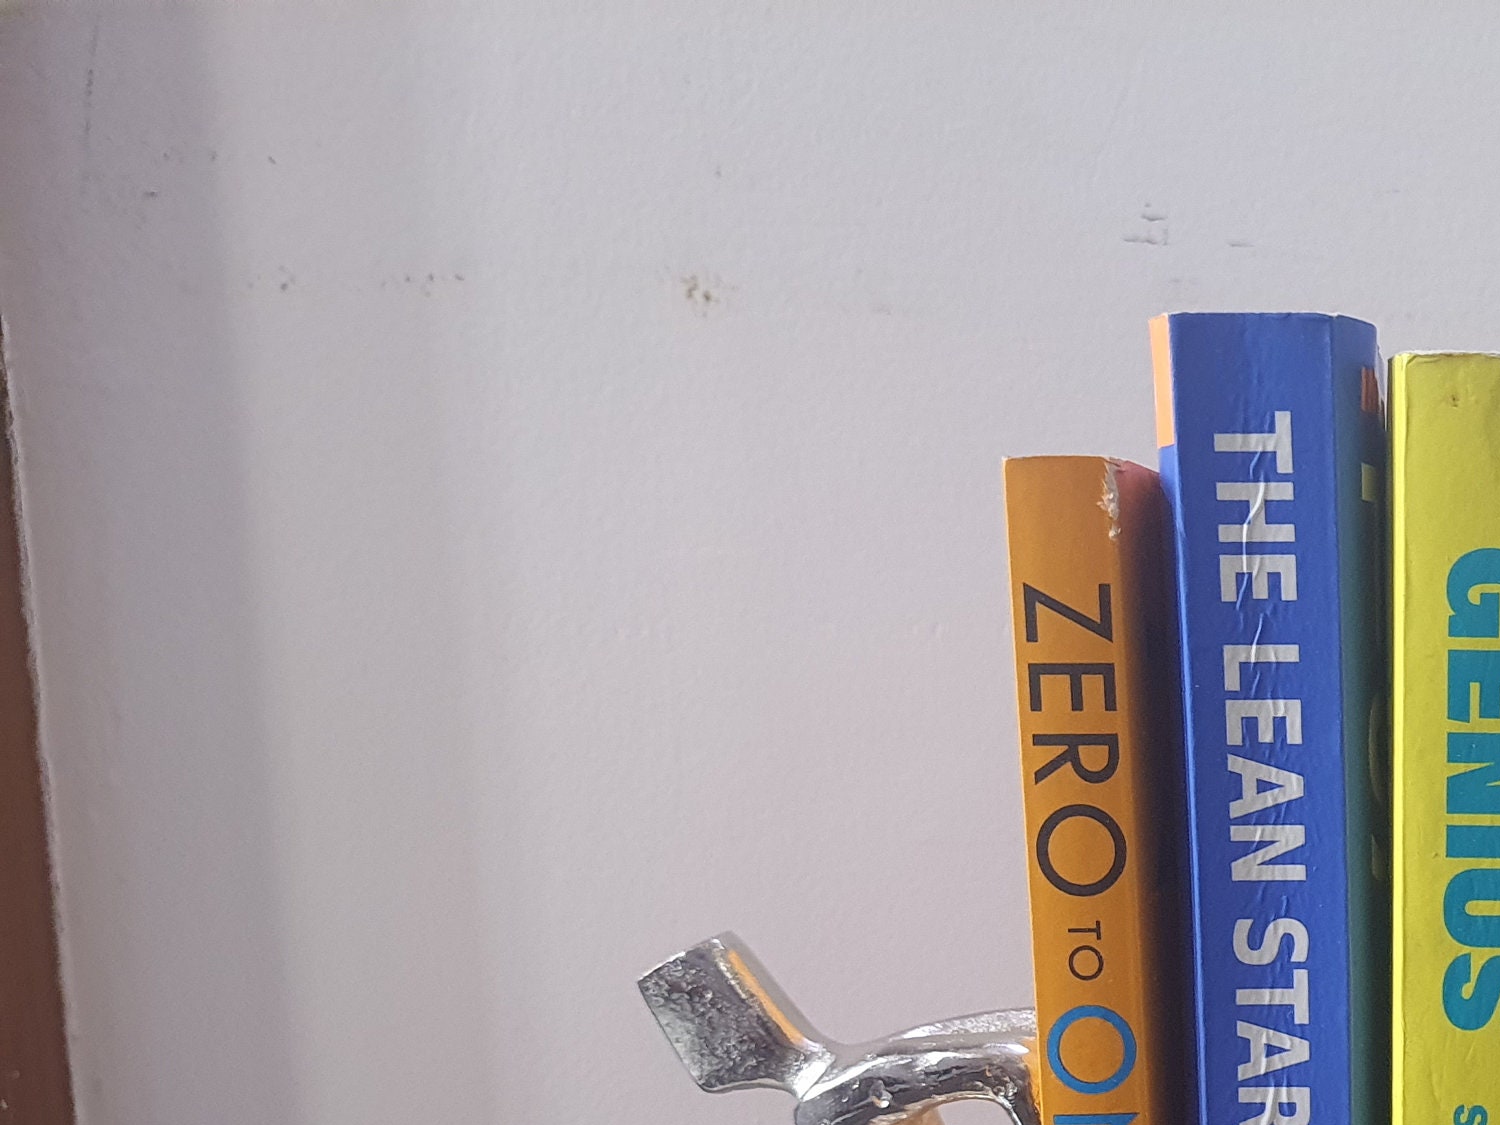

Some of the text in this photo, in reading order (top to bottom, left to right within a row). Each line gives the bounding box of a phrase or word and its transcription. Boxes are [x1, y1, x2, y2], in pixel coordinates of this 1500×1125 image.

[1213, 411, 1298, 602] THE
[1023, 582, 1127, 897] ZERO
[1224, 644, 1306, 882] LEAN
[1068, 921, 1103, 980] TO
